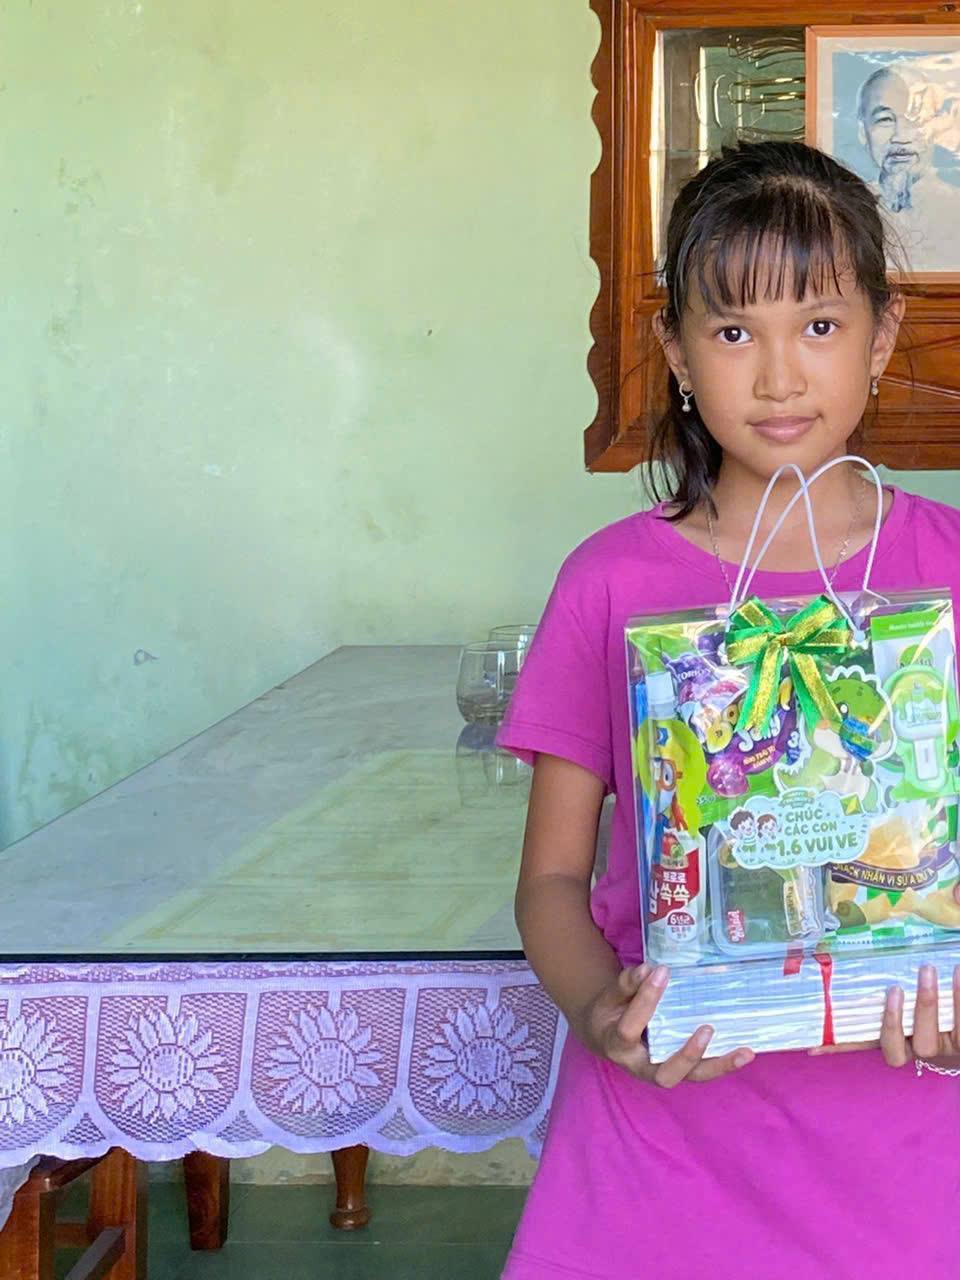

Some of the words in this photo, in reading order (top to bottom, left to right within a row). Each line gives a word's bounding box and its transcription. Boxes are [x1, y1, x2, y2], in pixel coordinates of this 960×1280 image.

[785, 807, 822, 822] CHÚC
[784, 823, 809, 836] CÁC
[812, 821, 838, 833] CON
[778, 840, 801, 856] 1.6
[805, 836, 833, 852] VUI
